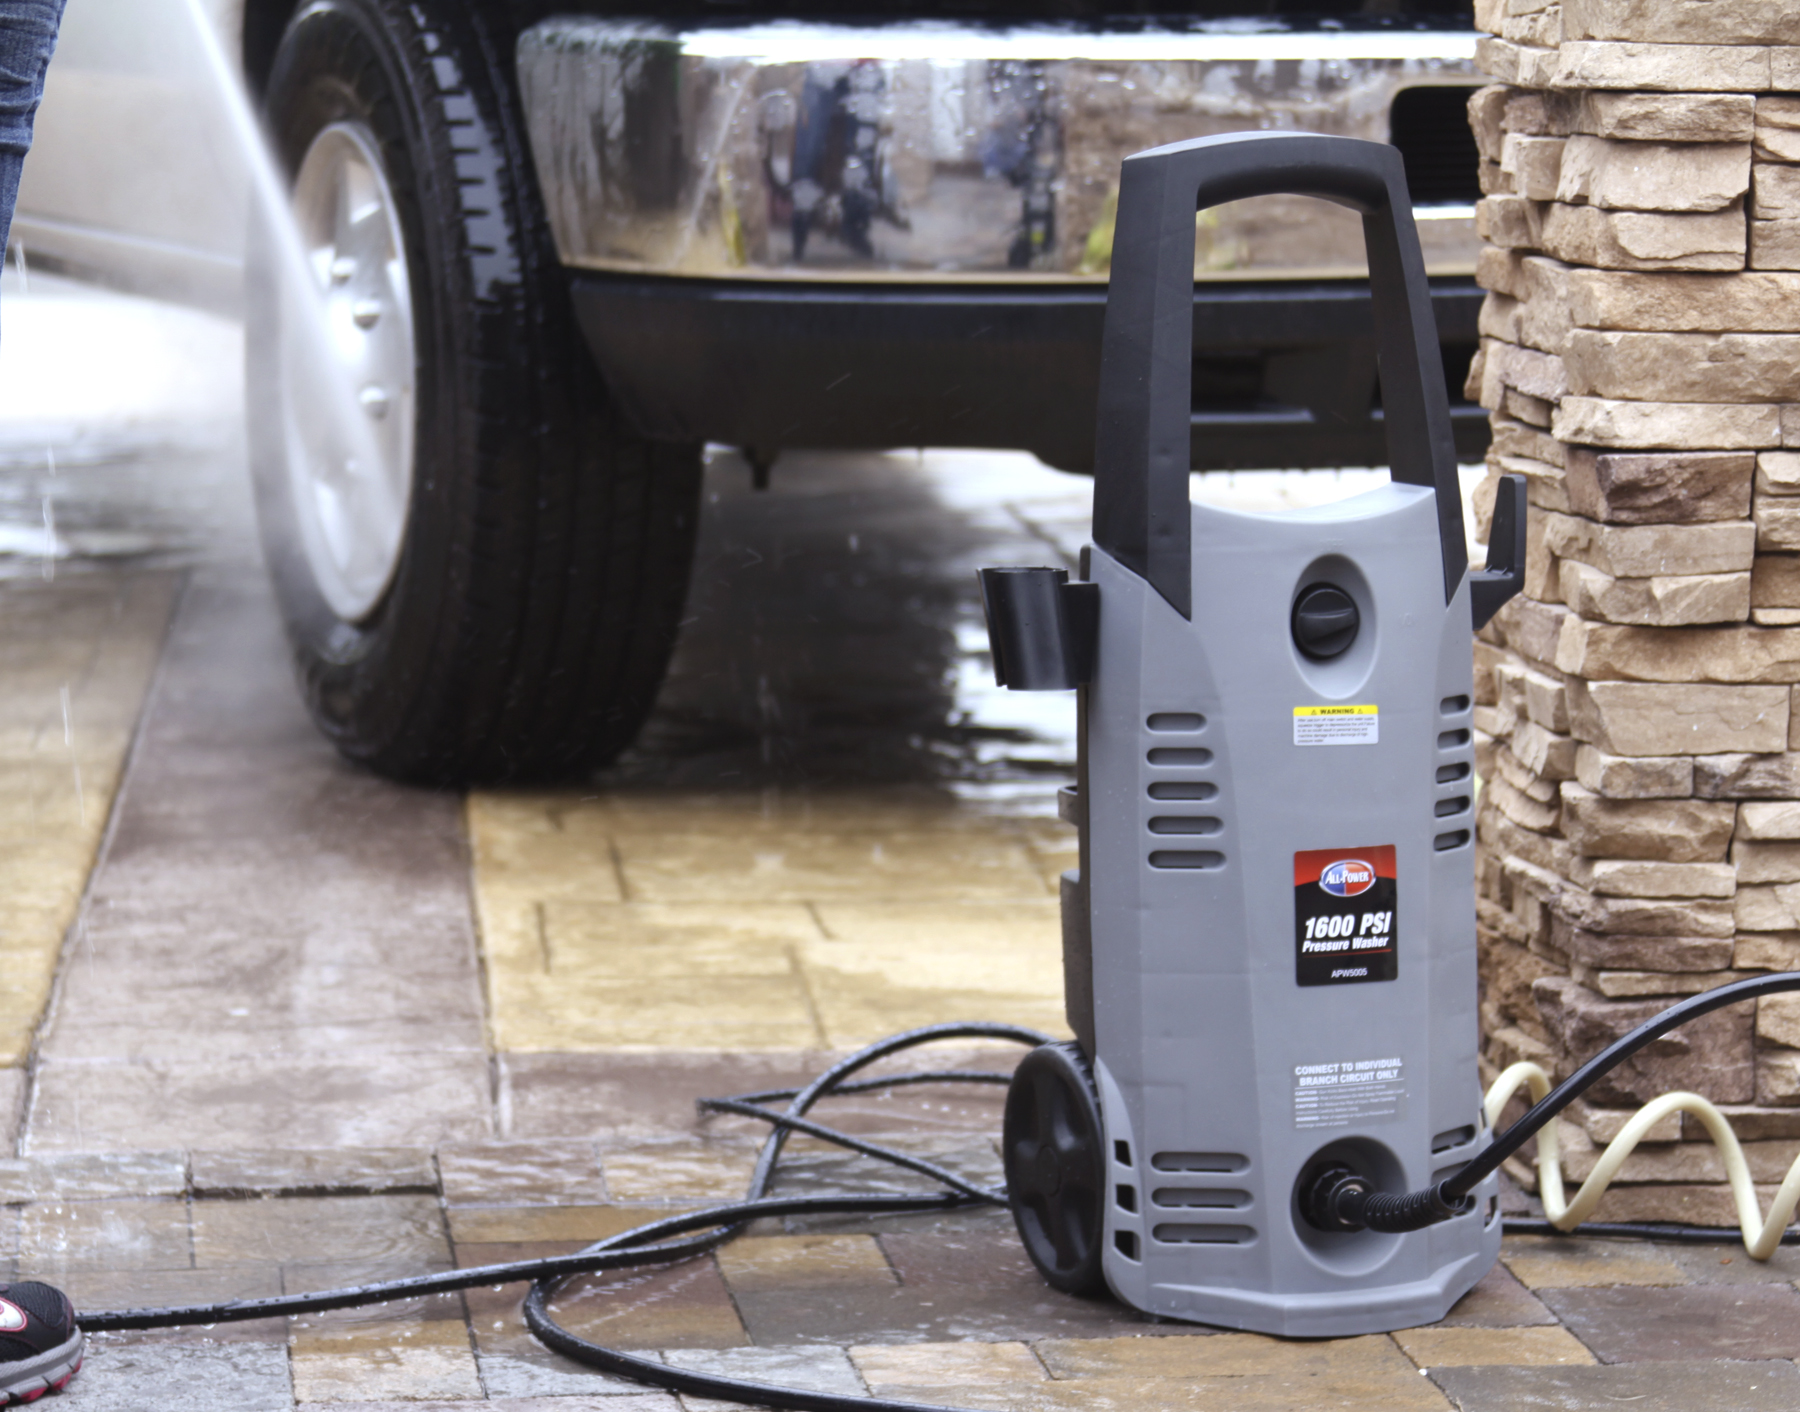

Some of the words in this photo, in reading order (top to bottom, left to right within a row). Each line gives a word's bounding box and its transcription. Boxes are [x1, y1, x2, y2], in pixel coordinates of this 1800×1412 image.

[1325, 870, 1369, 884] ALL-POWER
[1305, 914, 1356, 939] 1600
[1359, 910, 1392, 936] PSI
[1302, 939, 1350, 953] Pressure
[1352, 936, 1389, 950] Washer
[1331, 967, 1368, 979] APW5005
[1295, 1064, 1339, 1075] CONNECT
[1341, 1062, 1354, 1072] TO
[1355, 1058, 1402, 1070] INDIVIDUAL
[1299, 1075, 1339, 1087] BRANCH
[1340, 1071, 1375, 1083] CIRCUIT
[1376, 1069, 1398, 1080] ONLY
